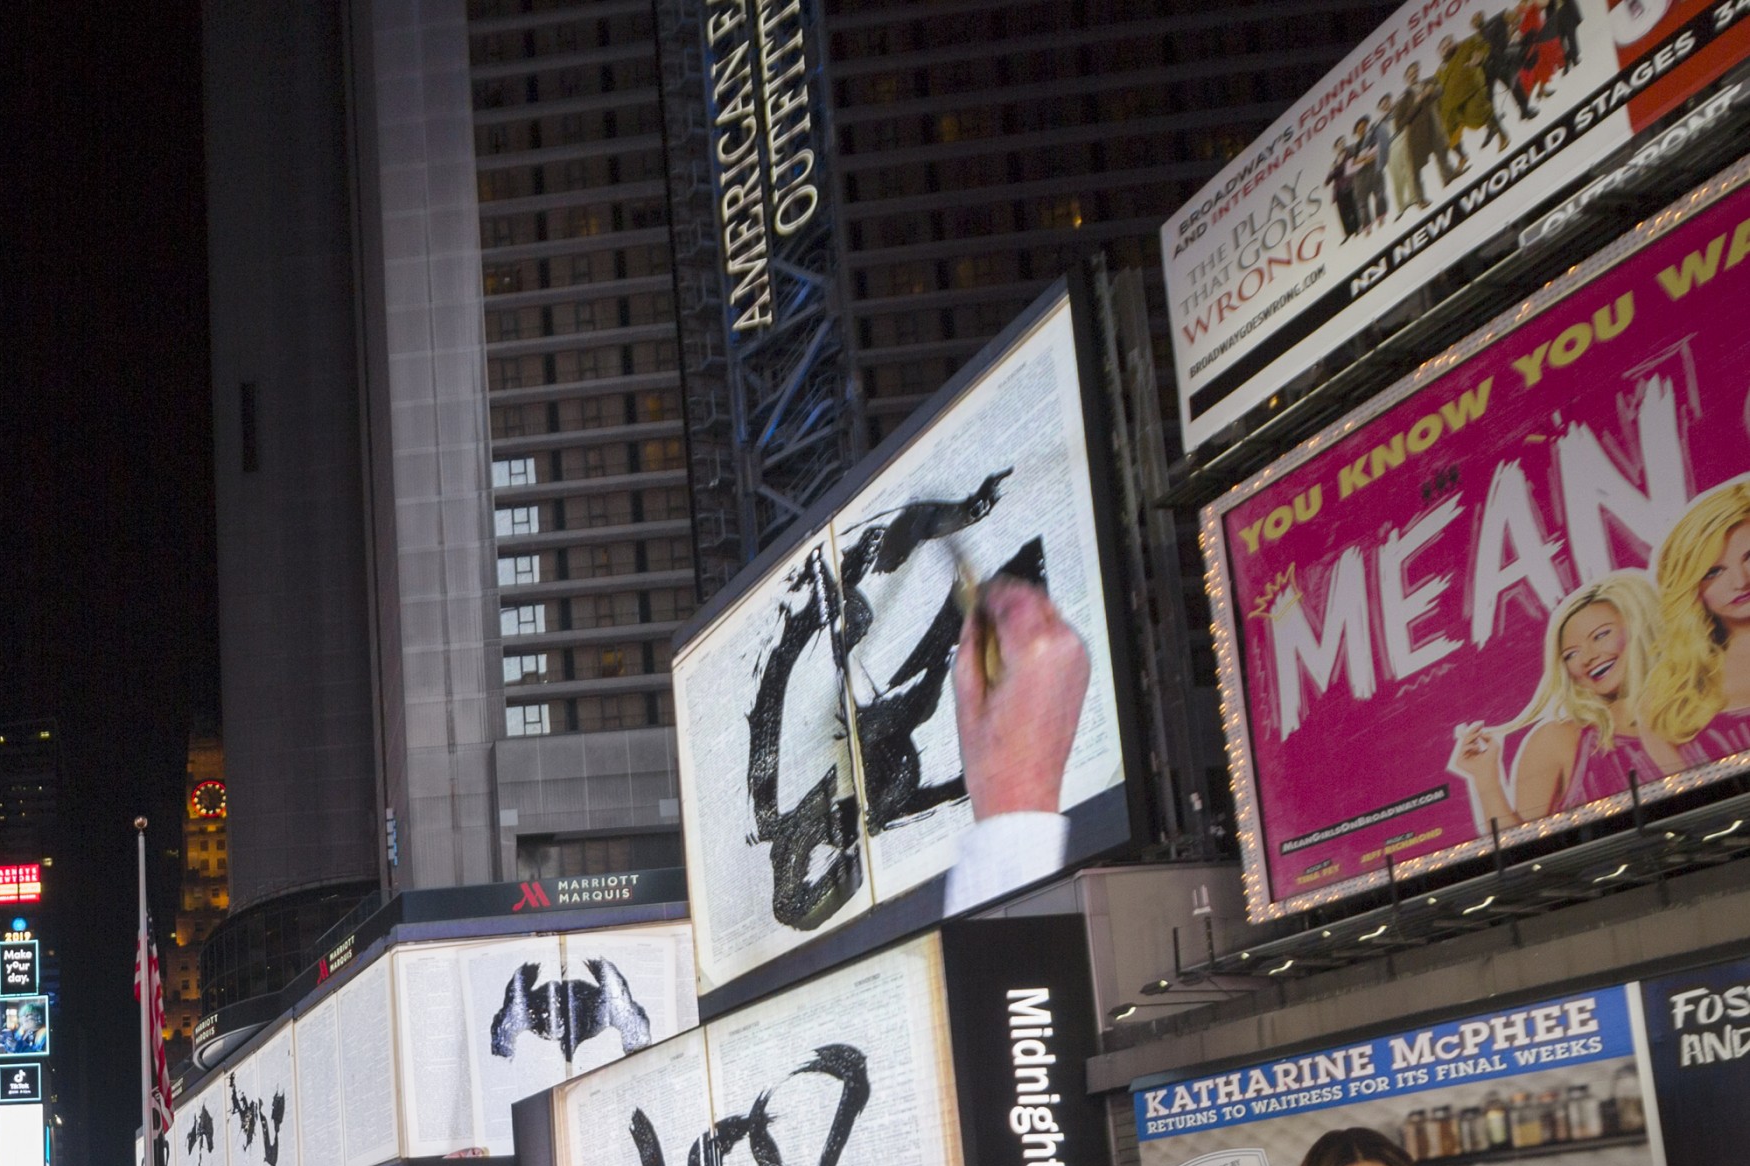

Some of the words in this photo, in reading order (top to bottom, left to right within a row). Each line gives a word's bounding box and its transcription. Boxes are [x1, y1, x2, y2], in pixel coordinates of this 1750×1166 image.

[713, 40, 773, 331] AMERICAN
[1173, 222, 1209, 259] AND
[1211, 79, 1375, 224] INTERNATIONAL
[1178, 124, 1294, 235] BROADWAY'S
[1298, 33, 1399, 135] FUNNIEST
[1394, 208, 1453, 264] NEW
[1459, 129, 1567, 212] WORLD
[1575, 30, 1697, 131] STAGES
[1180, 272, 1233, 316] THAT
[1237, 186, 1323, 272] GOES
[1187, 247, 1228, 285] THE
[1232, 171, 1305, 248] PLAY
[1182, 225, 1327, 346] WRONG
[1189, 264, 1327, 379] BROADWAYGOESWRONG.COM
[1238, 488, 1324, 554] YOU
[1340, 376, 1494, 503] KNOW
[1510, 291, 1636, 388] YOU
[1266, 372, 1692, 742] MEAN
[5, 931, 32, 942] 2019
[558, 873, 640, 892] MARRIOTT
[559, 887, 632, 904] MARQUIS
[4, 949, 33, 960] Make
[6, 961, 31, 975] your
[7, 972, 30, 984] day.
[1144, 1044, 1375, 1118] KATHARINE
[1146, 1108, 1218, 1134] RETURNS
[1221, 1103, 1246, 1122] TO
[1250, 1084, 1344, 1116] WAITRESS
[1348, 1073, 1390, 1099] FOR
[1395, 1065, 1430, 1087] ITS
[1434, 1055, 1506, 1082] FINAL
[1514, 1035, 1603, 1068] WEEKS
